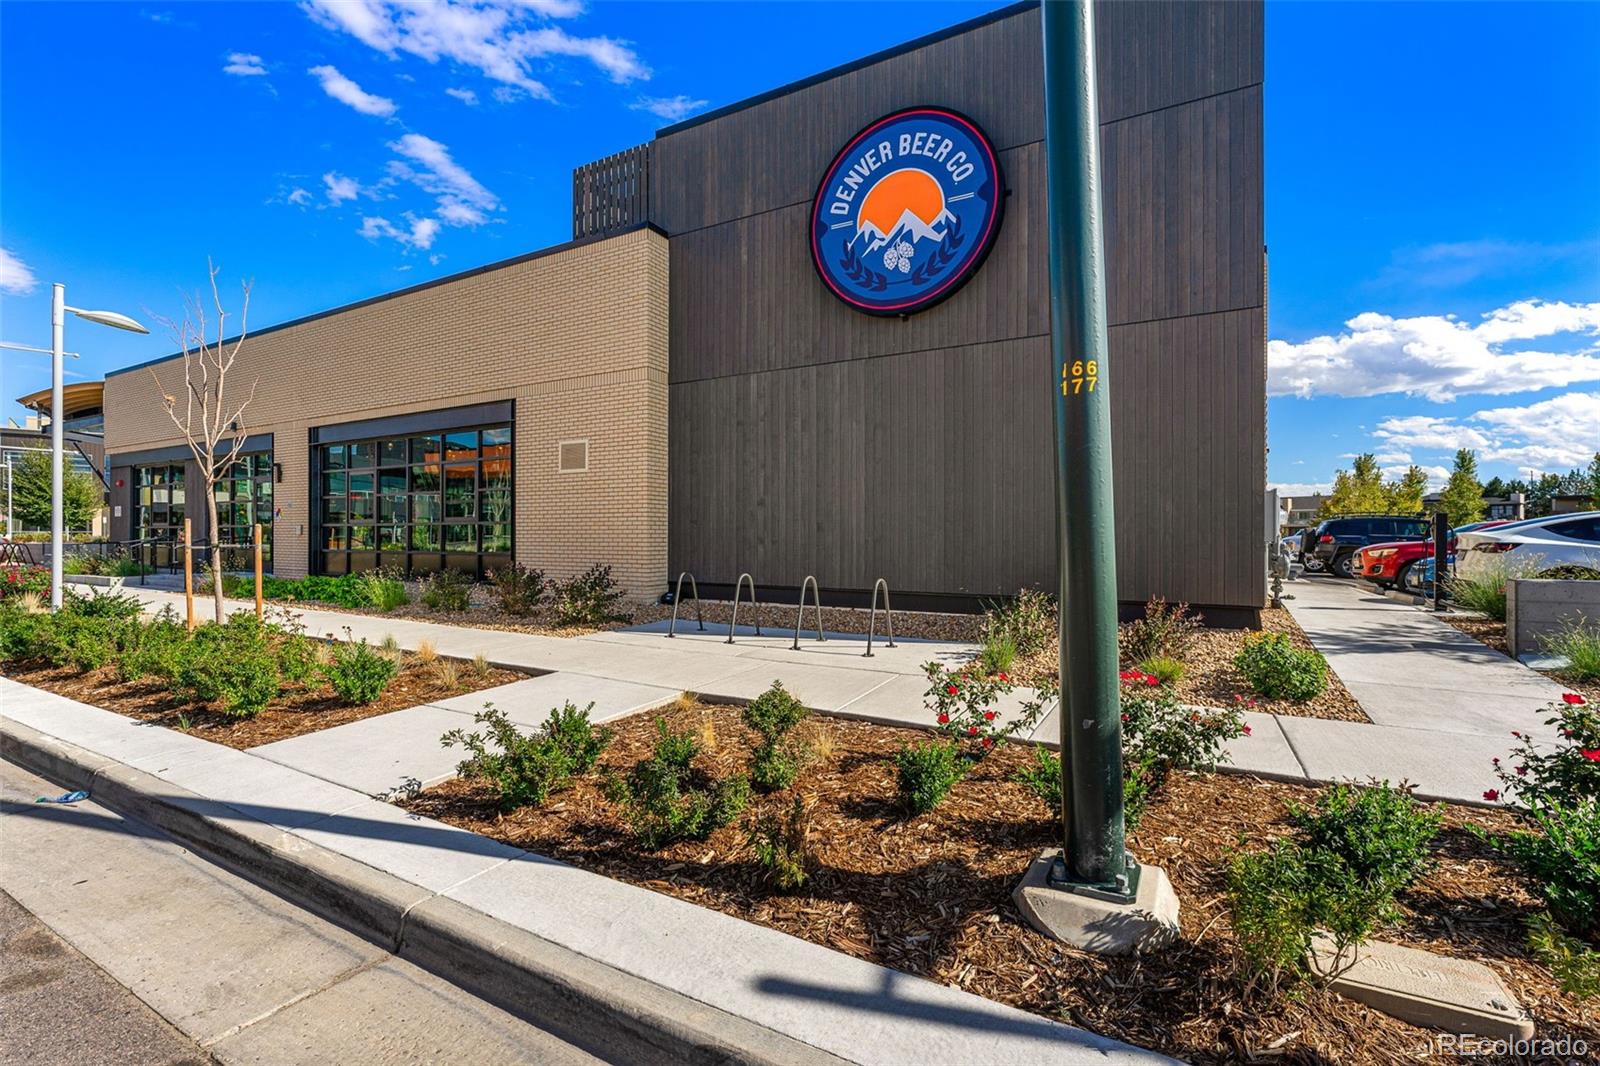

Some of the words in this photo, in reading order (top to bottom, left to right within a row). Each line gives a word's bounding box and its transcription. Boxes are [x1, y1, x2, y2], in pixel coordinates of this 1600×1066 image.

[830, 141, 893, 216] DENVER
[898, 132, 953, 163] BEER
[945, 151, 975, 185] CO.
[1062, 360, 1098, 378] 166
[1060, 376, 1098, 396] 177
